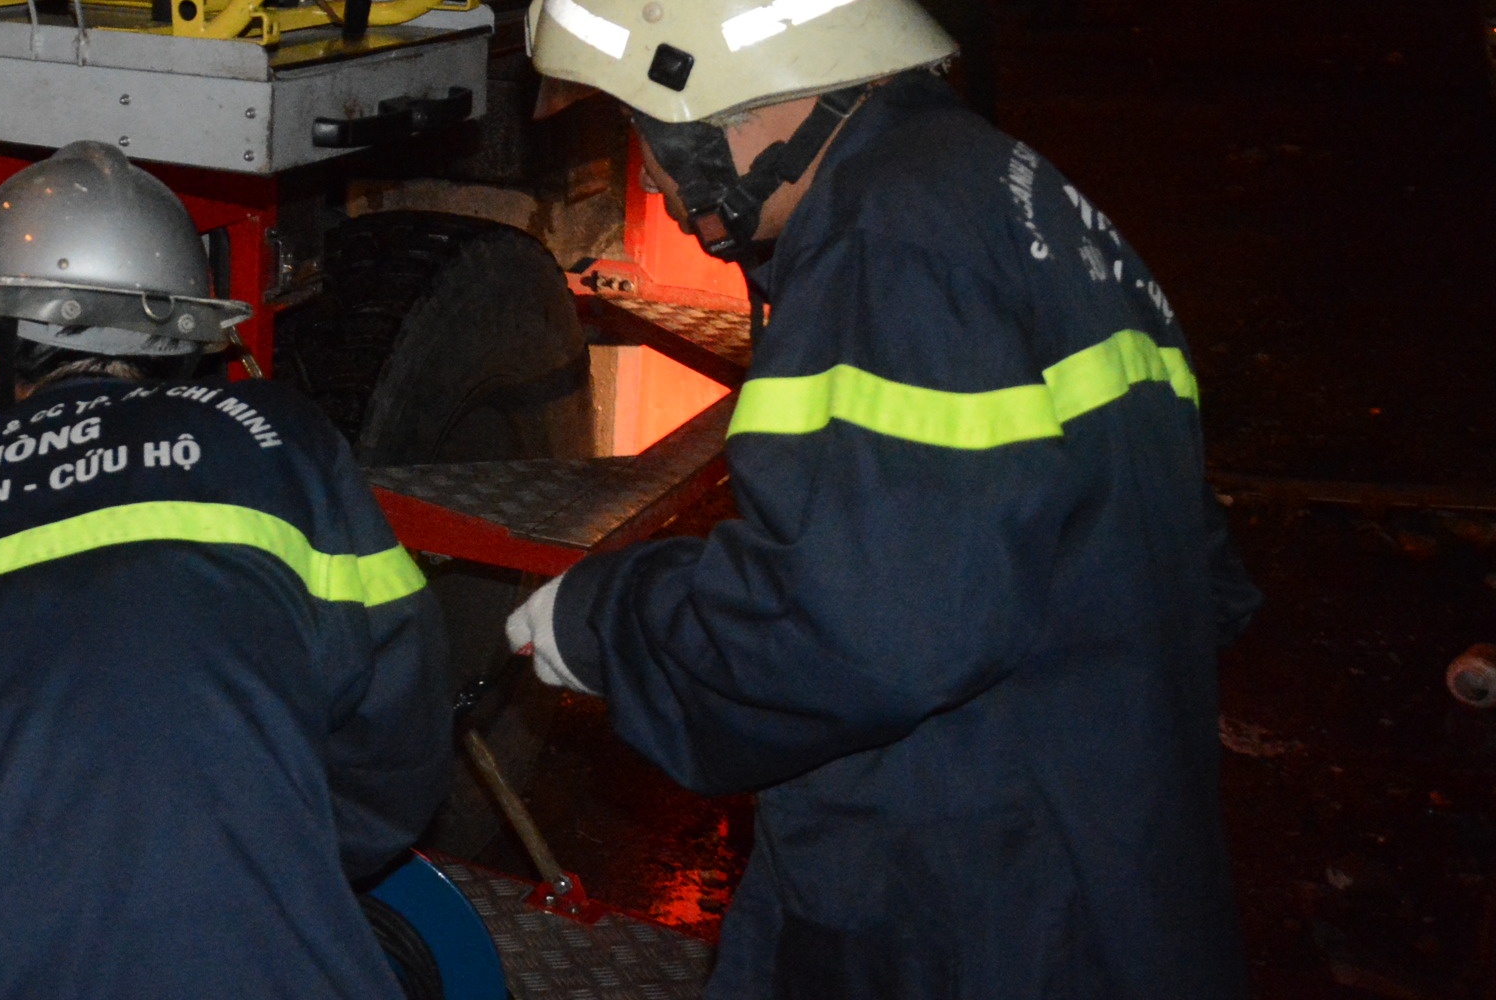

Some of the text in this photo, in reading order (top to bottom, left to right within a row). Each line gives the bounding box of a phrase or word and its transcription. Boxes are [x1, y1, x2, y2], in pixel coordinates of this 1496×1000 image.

[215, 397, 283, 448] MINH
[49, 444, 128, 490] CỨU
[143, 433, 201, 471] HỘ
